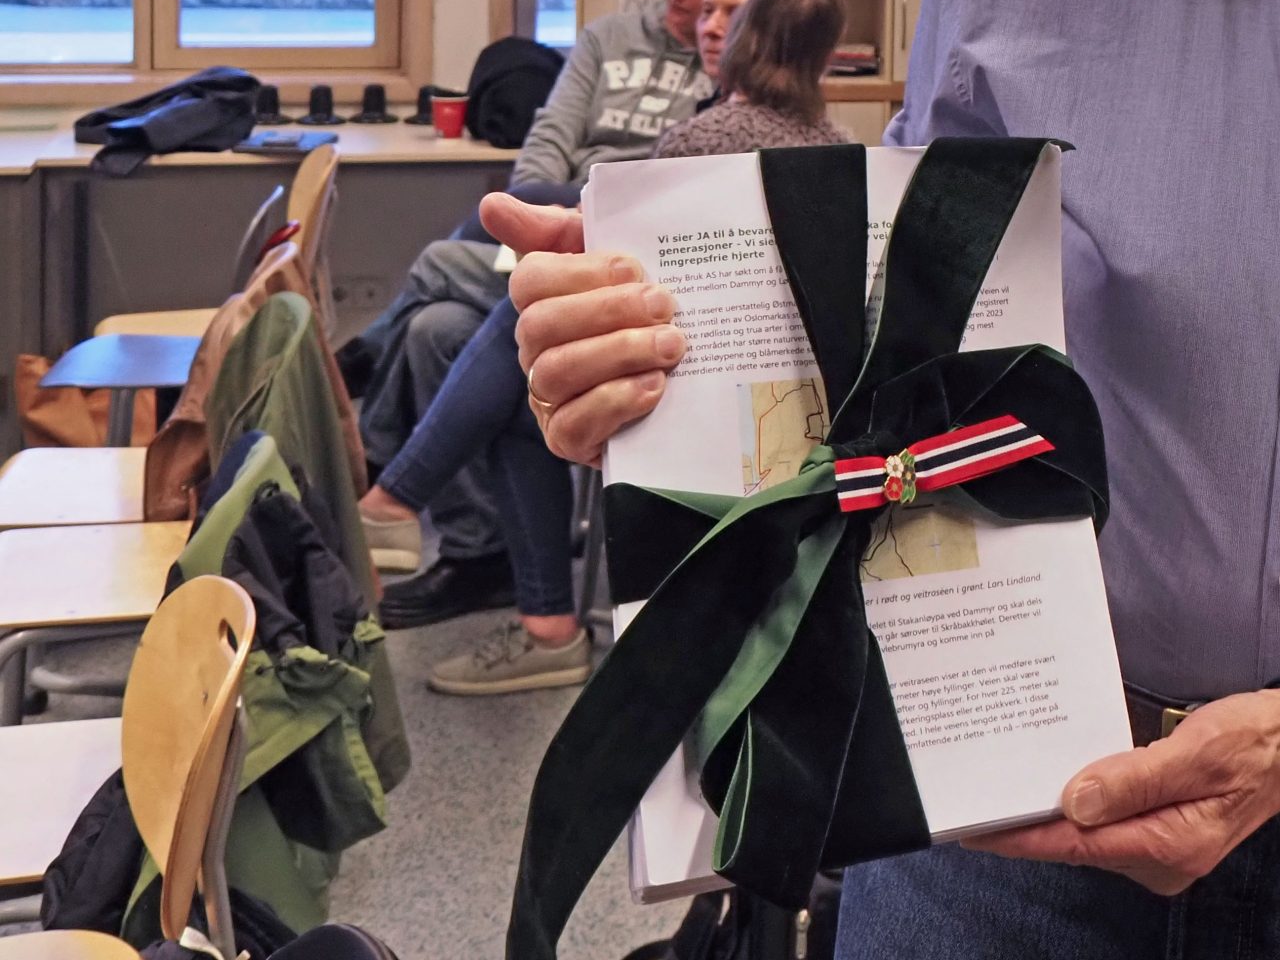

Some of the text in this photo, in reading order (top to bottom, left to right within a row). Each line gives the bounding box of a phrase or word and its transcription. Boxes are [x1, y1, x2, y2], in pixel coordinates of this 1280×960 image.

[658, 234, 669, 244] Vi
[672, 233, 693, 243] sier
[697, 231, 710, 240] JA
[713, 229, 725, 239] til
[728, 228, 735, 237] å
[658, 242, 733, 258] generasjoner
[745, 237, 755, 247] Vi
[759, 236, 775, 246] sie
[659, 250, 765, 268] inngrepsfrie hjerte
[658, 274, 682, 285] Losby
[685, 272, 703, 282] Bruk
[706, 271, 717, 280] AS
[719, 270, 732, 278] har
[734, 267, 751, 277] søkt
[698, 282, 727, 292] mellom
[730, 280, 765, 289] Dammyr
[766, 279, 777, 287] og
[686, 307, 696, 316] vil
[698, 307, 723, 315] rasere
[725, 301, 770, 313] uerstattelig
[1001, 285, 1009, 294] vil
[698, 317, 717, 327] inntil
[745, 311, 789, 323] Oslomarkas
[976, 297, 1009, 309] registrert
[695, 340, 731, 351] området
[733, 338, 745, 347] har
[748, 337, 771, 345] større
[976, 321, 994, 330] mest
[701, 329, 731, 339] rødlista
[733, 329, 744, 338] og
[746, 327, 762, 335] trua
[764, 324, 782, 333] arter
[986, 308, 1003, 318] 2023
[700, 353, 744, 363] skiløypene
[747, 351, 757, 360] og
[760, 345, 804, 357] blåmerkede
[725, 363, 734, 373] vil
[737, 362, 757, 371] dette
[760, 361, 781, 369] være
[881, 594, 898, 604] rødt
[900, 594, 910, 603] og
[988, 580, 1004, 589] Lars
[1007, 574, 1041, 586] Lindland
[947, 608, 960, 618] ved
[963, 605, 995, 616] Dammyr
[998, 603, 1008, 612] og
[1010, 598, 1024, 609] skal
[1027, 596, 1042, 606] dels
[886, 631, 898, 642] går
[900, 628, 929, 638] sørover
[999, 612, 1030, 622] Deretter
[1033, 608, 1041, 617] vil
[927, 639, 938, 648] og
[940, 634, 968, 644] komme
[971, 631, 983, 640] inn
[985, 628, 995, 640] på
[896, 691, 919, 701] meter
[921, 688, 941, 697] høye
[978, 677, 1001, 687] Veien
[1003, 672, 1018, 683] skal
[1020, 671, 1039, 680] være
[900, 676, 939, 688] veitraseen
[941, 672, 960, 681] viser
[962, 669, 970, 678] at
[972, 667, 987, 676] den
[988, 664, 997, 673] vil
[999, 660, 1032, 671] medføre
[1034, 655, 1055, 665] svært
[918, 702, 929, 711] og
[966, 693, 979, 701] For
[981, 690, 998, 699] hver
[1019, 682, 1041, 692] meter
[1044, 677, 1059, 688] skal
[956, 706, 972, 715] eller
[975, 703, 983, 712] et
[1029, 693, 1049, 703] disse
[924, 724, 941, 734] hele
[944, 720, 969, 730] veiens
[970, 714, 998, 726] lengde
[1000, 710, 1015, 720] skal
[1029, 705, 1046, 717] gate
[1048, 702, 1059, 714] på
[953, 733, 962, 742] at
[963, 730, 984, 740] dette
[993, 725, 1001, 735] til
[1003, 723, 1013, 733] nå
[1021, 713, 1068, 729] inngrepsfrie
